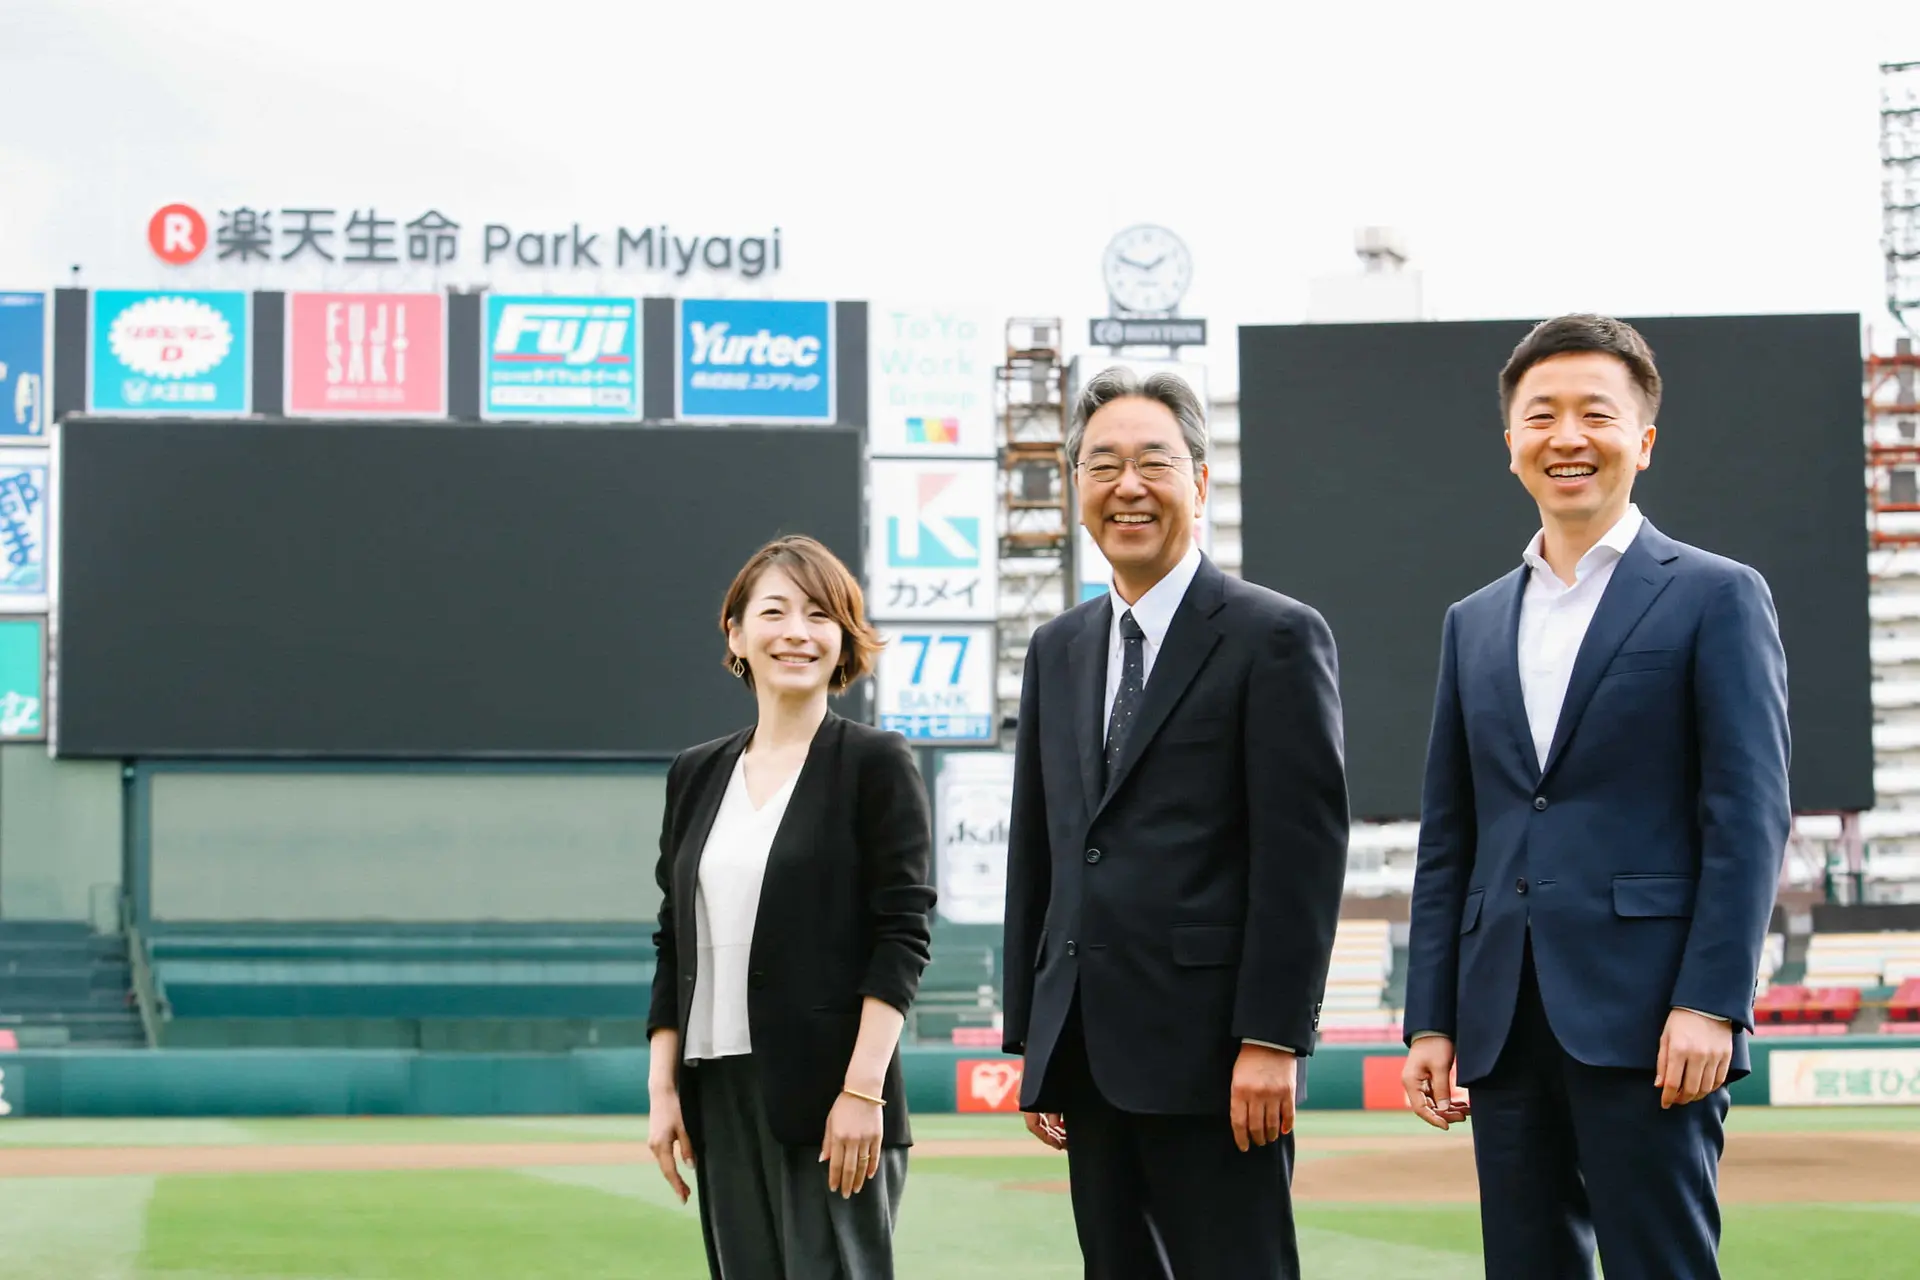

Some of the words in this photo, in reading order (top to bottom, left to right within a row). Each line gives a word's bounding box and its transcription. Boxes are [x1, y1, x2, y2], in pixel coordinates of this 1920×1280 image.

[216, 206, 461, 266] 楽天生命
[484, 224, 600, 267] Park
[617, 225, 782, 278] Miyagi
[161, 346, 183, 363] D
[493, 304, 632, 366] Fuji
[689, 319, 821, 368] Yurtec
[888, 577, 980, 608] カメイ
[900, 635, 970, 685] 77
